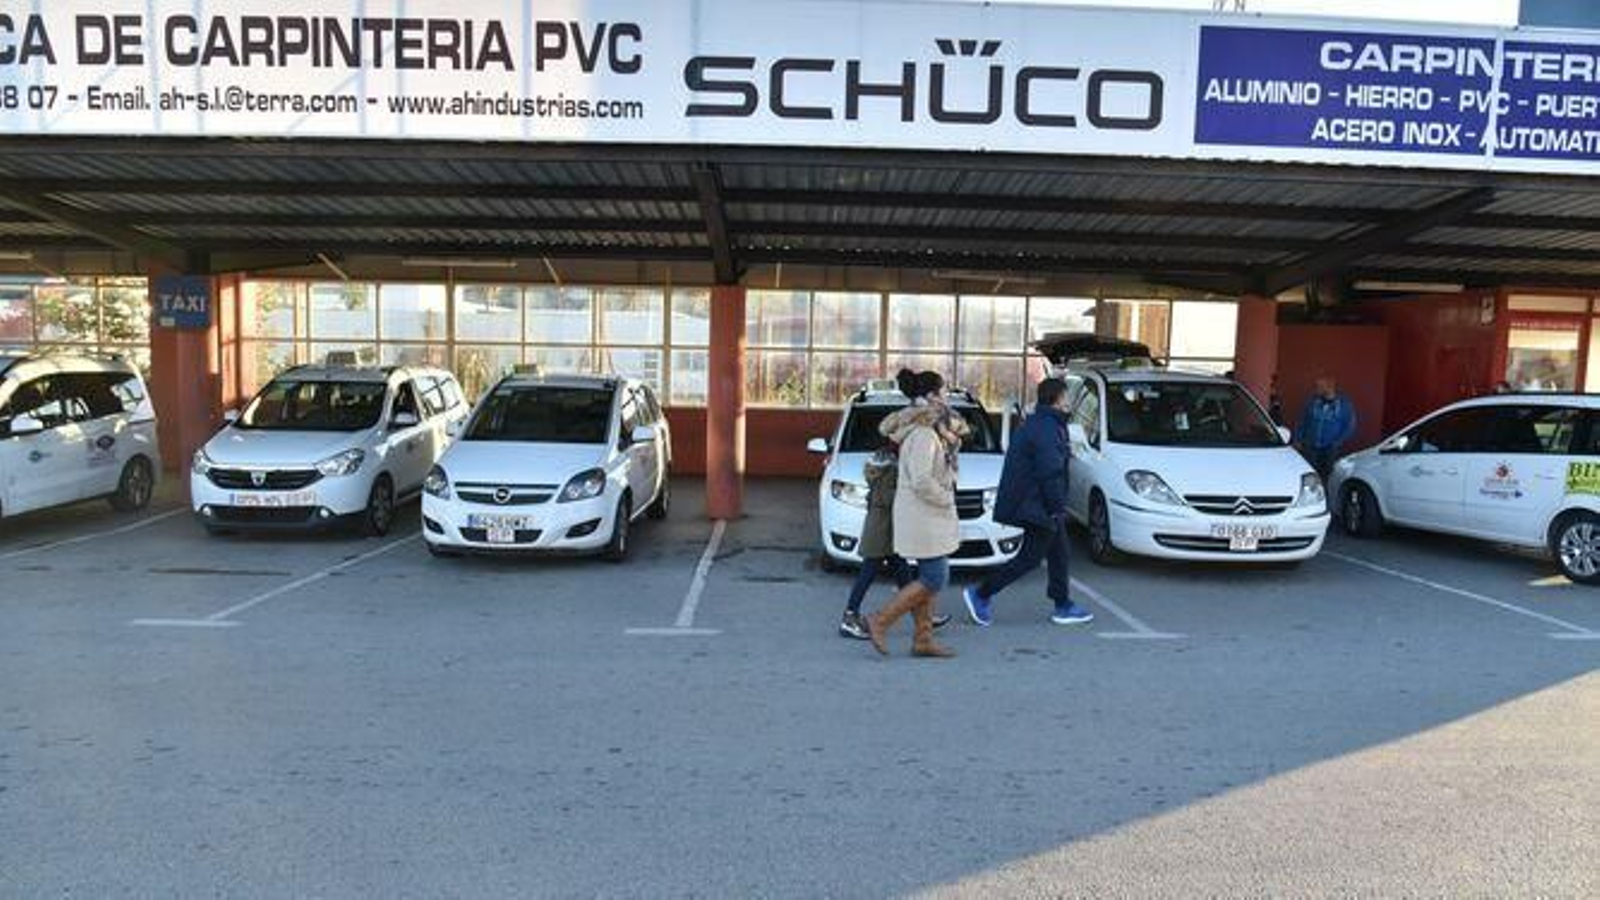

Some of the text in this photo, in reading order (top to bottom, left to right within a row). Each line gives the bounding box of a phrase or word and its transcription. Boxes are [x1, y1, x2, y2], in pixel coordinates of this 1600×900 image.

[75, 14, 144, 66] DE
[164, 15, 515, 72] CARPINTERIA
[534, 21, 642, 74] PVC
[27, 85, 58, 110] 07
[87, 85, 151, 111] Email.
[159, 86, 358, 113] ah-s.l.@terra.com
[388, 91, 643, 119] www.ahindustrias.com
[684, 39, 1164, 130] SCHÜCO
[1203, 78, 1321, 106] ALUMINIO
[1345, 84, 1433, 111] HIERRO
[1459, 89, 1510, 115] PVC
[1536, 94, 1600, 118] PUER
[1311, 118, 1395, 144] ACERO
[1402, 121, 1462, 147] INOX
[160, 293, 206, 312] TAXI
